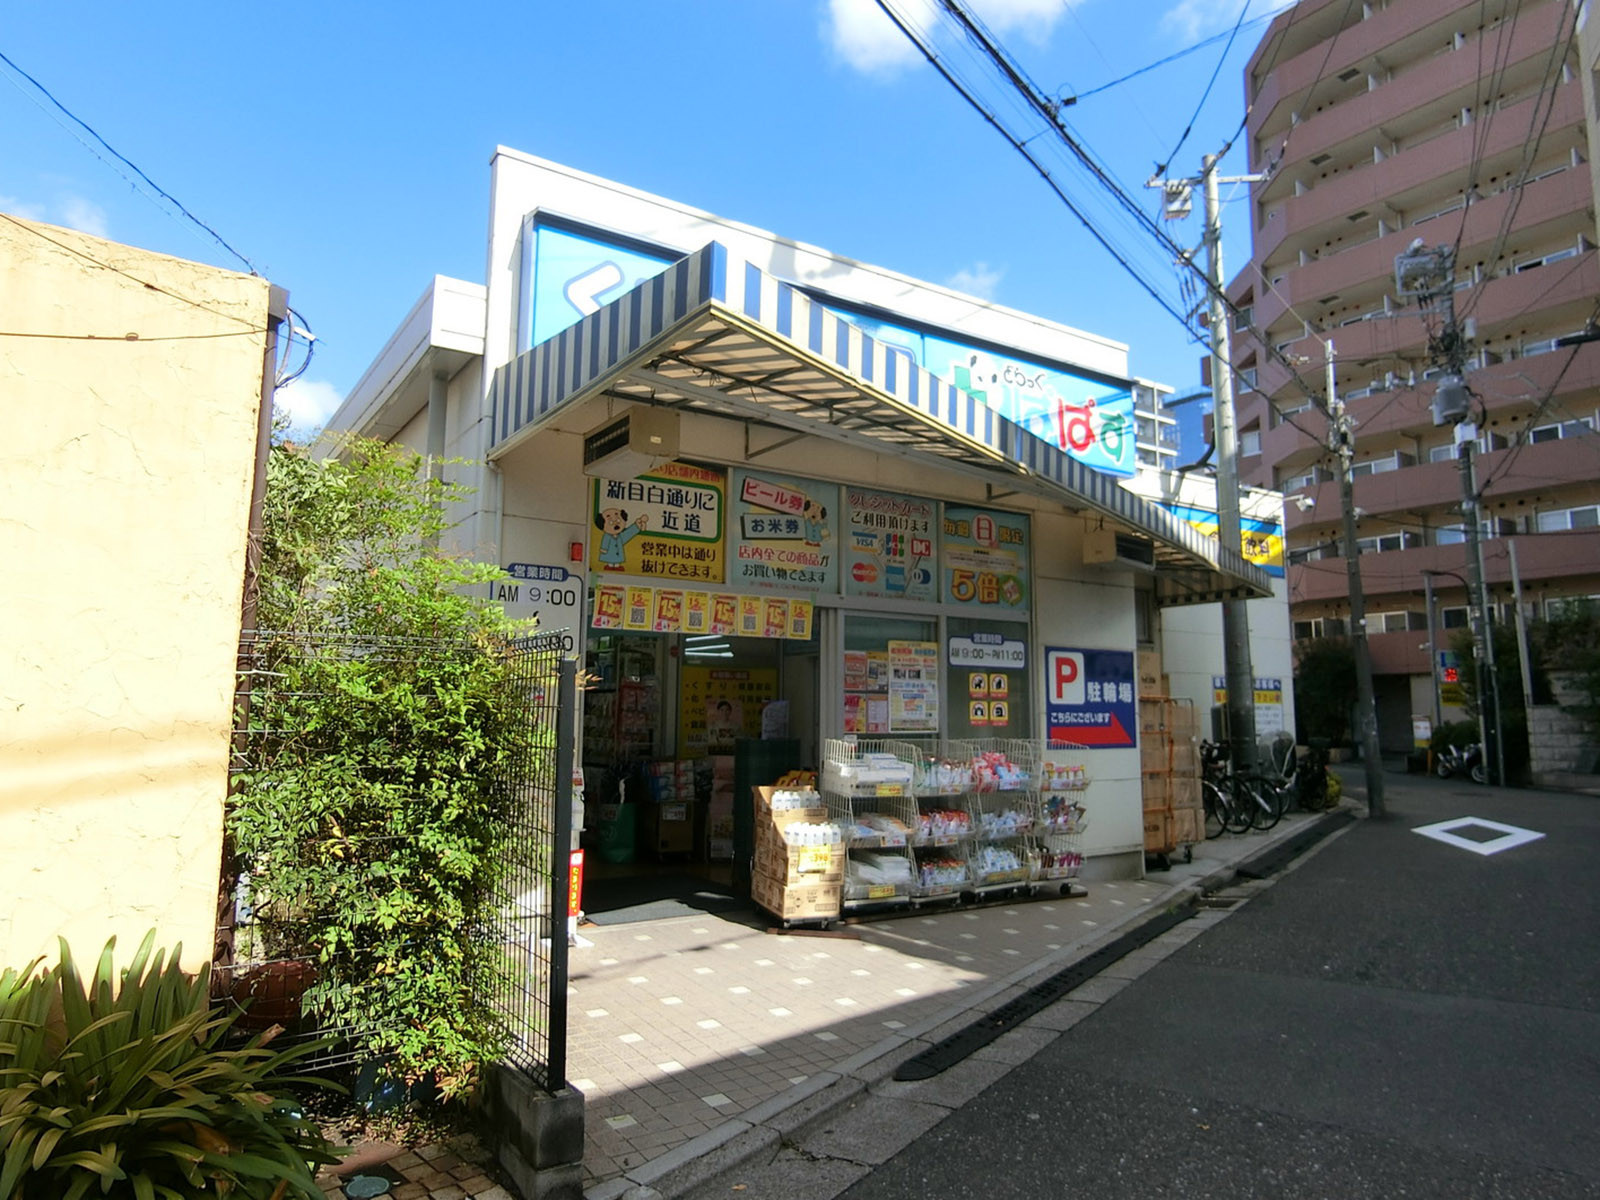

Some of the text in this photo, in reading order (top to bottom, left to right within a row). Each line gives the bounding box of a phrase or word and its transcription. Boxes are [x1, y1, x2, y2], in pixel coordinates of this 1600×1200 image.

[607, 480, 715, 511] 新目白通りに
[745, 481, 804, 511] ビール券
[662, 511, 701, 533] 近道
[751, 519, 800, 534] お米券
[851, 511, 929, 533] ご利用頂けます
[641, 542, 716, 562] 営業中は通り
[856, 538, 874, 548] VISA
[913, 540, 930, 555] DC
[738, 545, 830, 567] 店内全ての商品が
[514, 564, 563, 580] 営業時間
[742, 564, 826, 584] お買い物できます
[498, 584, 576, 606] AM 9:00
[951, 568, 1000, 604] 5倍
[1055, 656, 1078, 699] P
[1087, 682, 1132, 703] 駐輪場
[1050, 712, 1110, 724] こちらにございます
